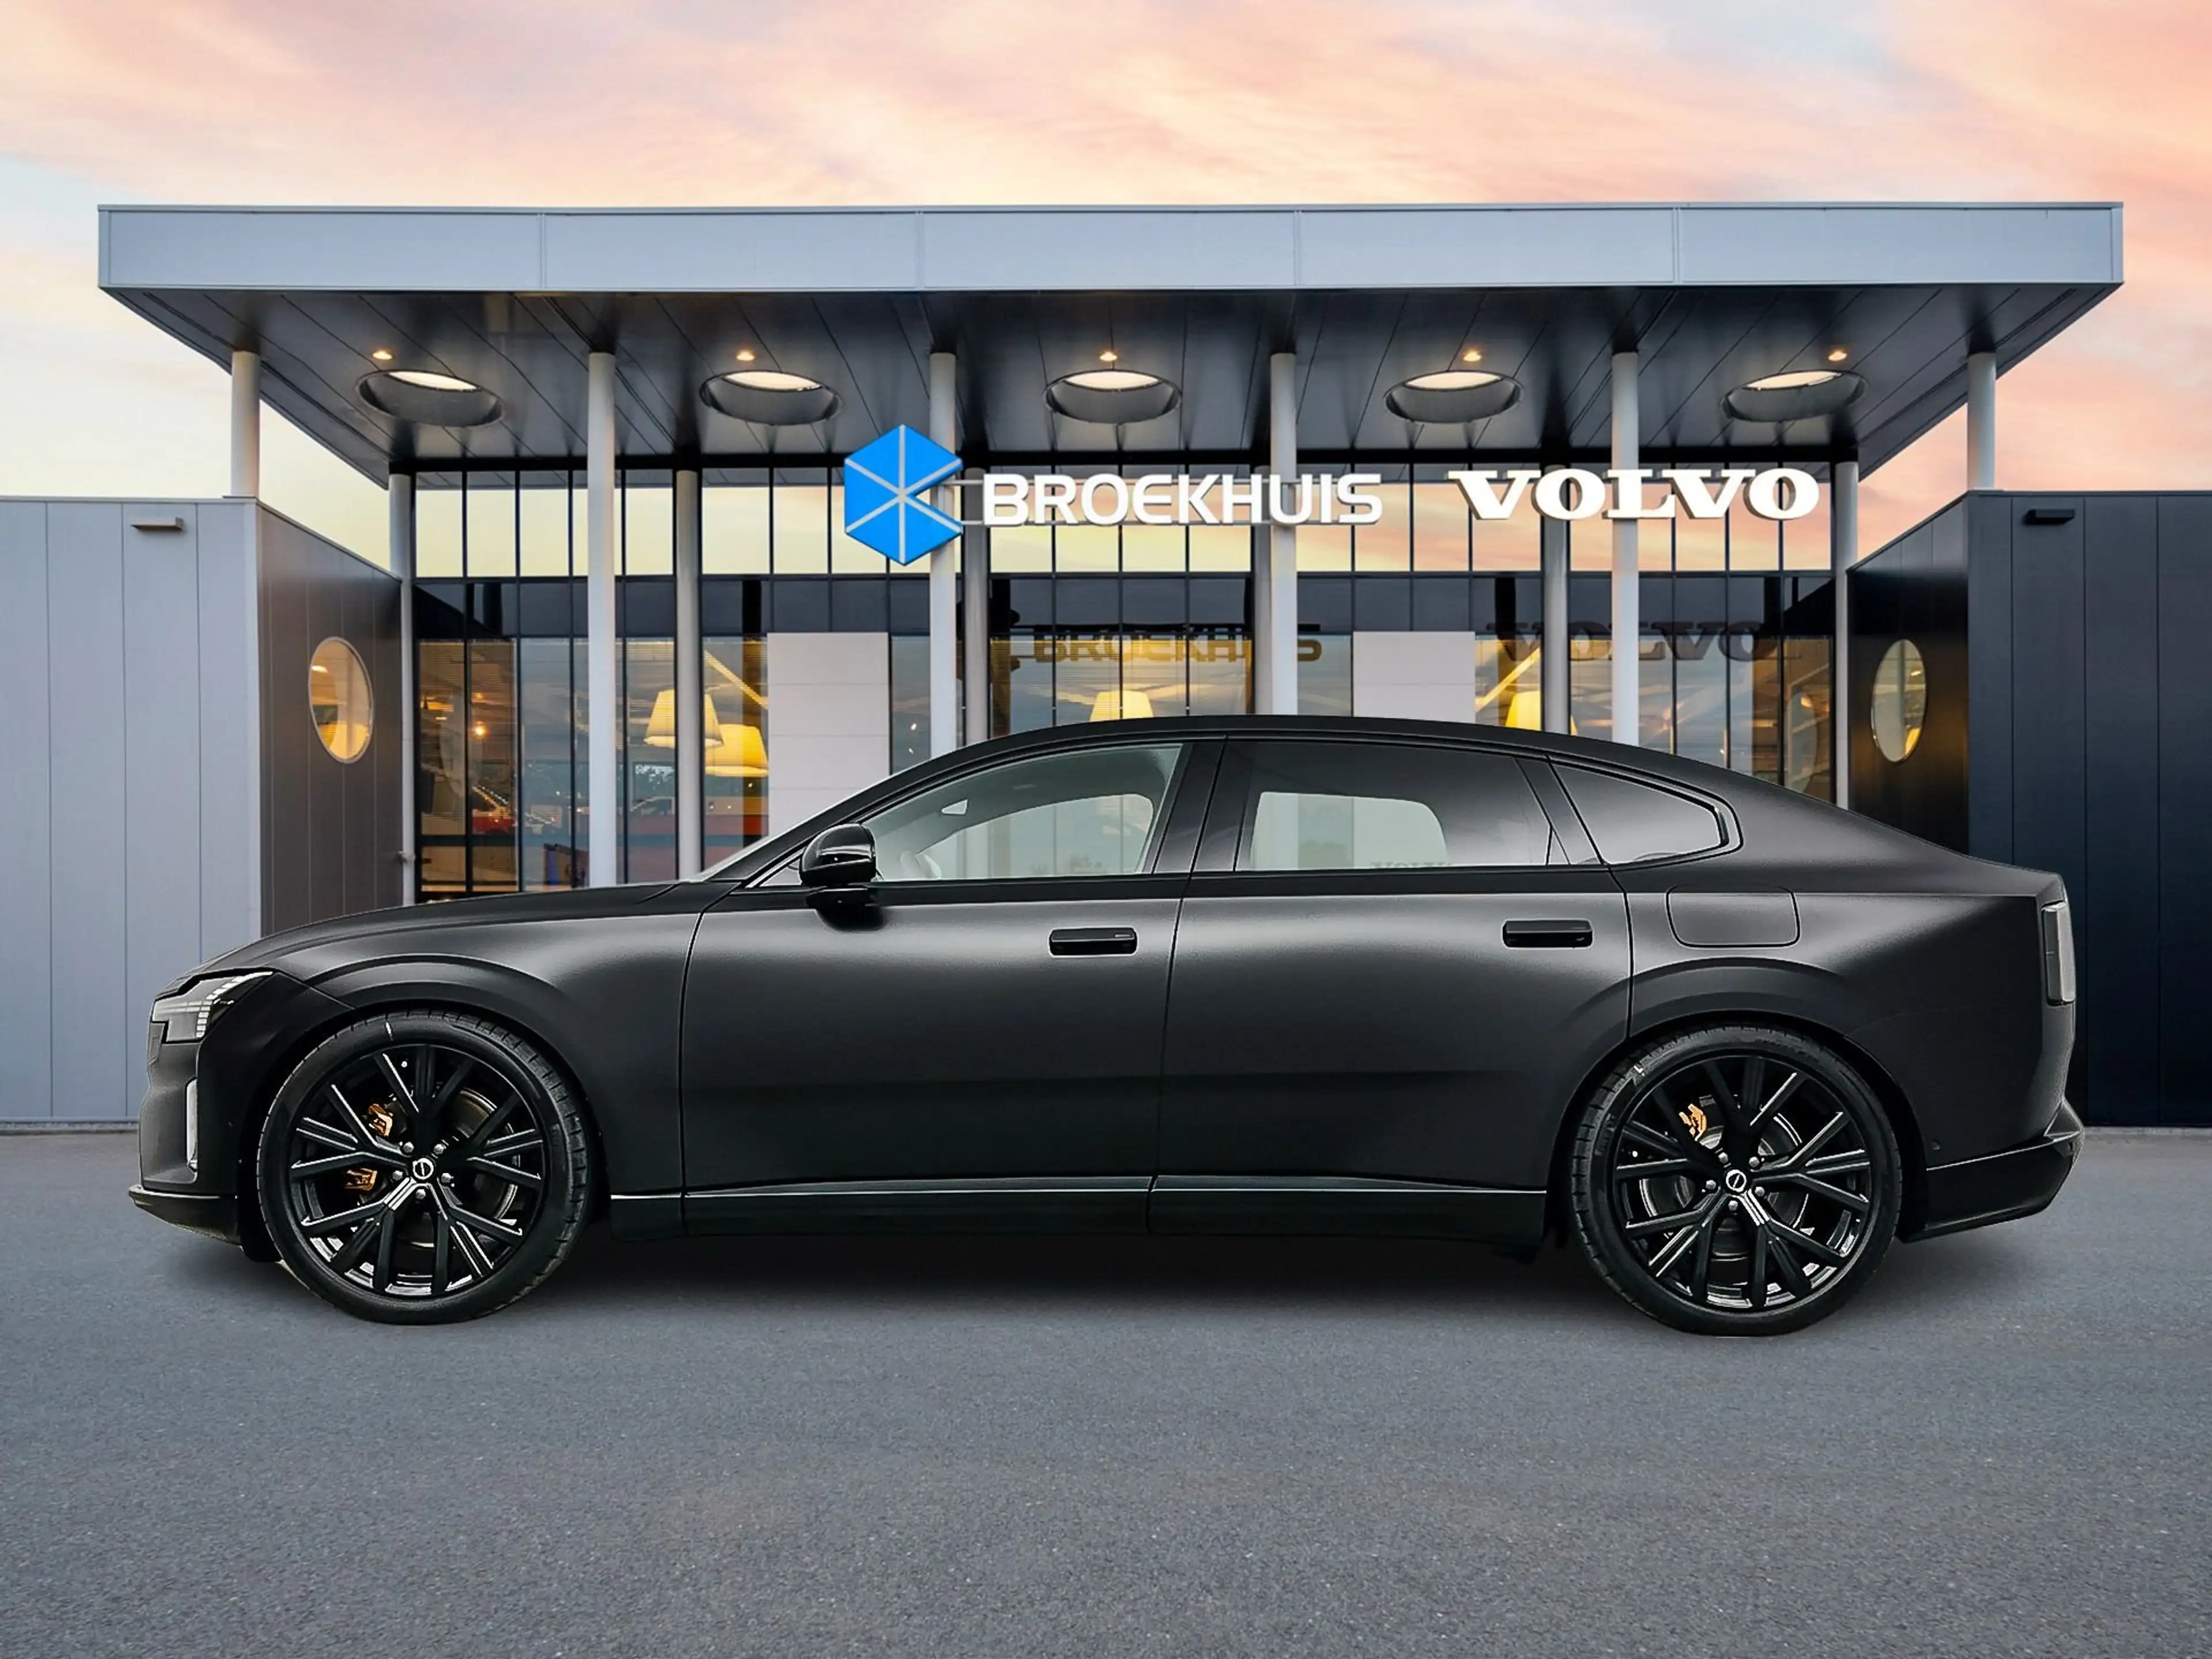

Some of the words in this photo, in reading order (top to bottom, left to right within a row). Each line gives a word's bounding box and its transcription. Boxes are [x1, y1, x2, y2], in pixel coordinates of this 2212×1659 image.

[983, 473, 1383, 525] BROEKHUIS
[1447, 468, 1820, 520] VOLVO
[1033, 625, 1323, 662] BROEKHS
